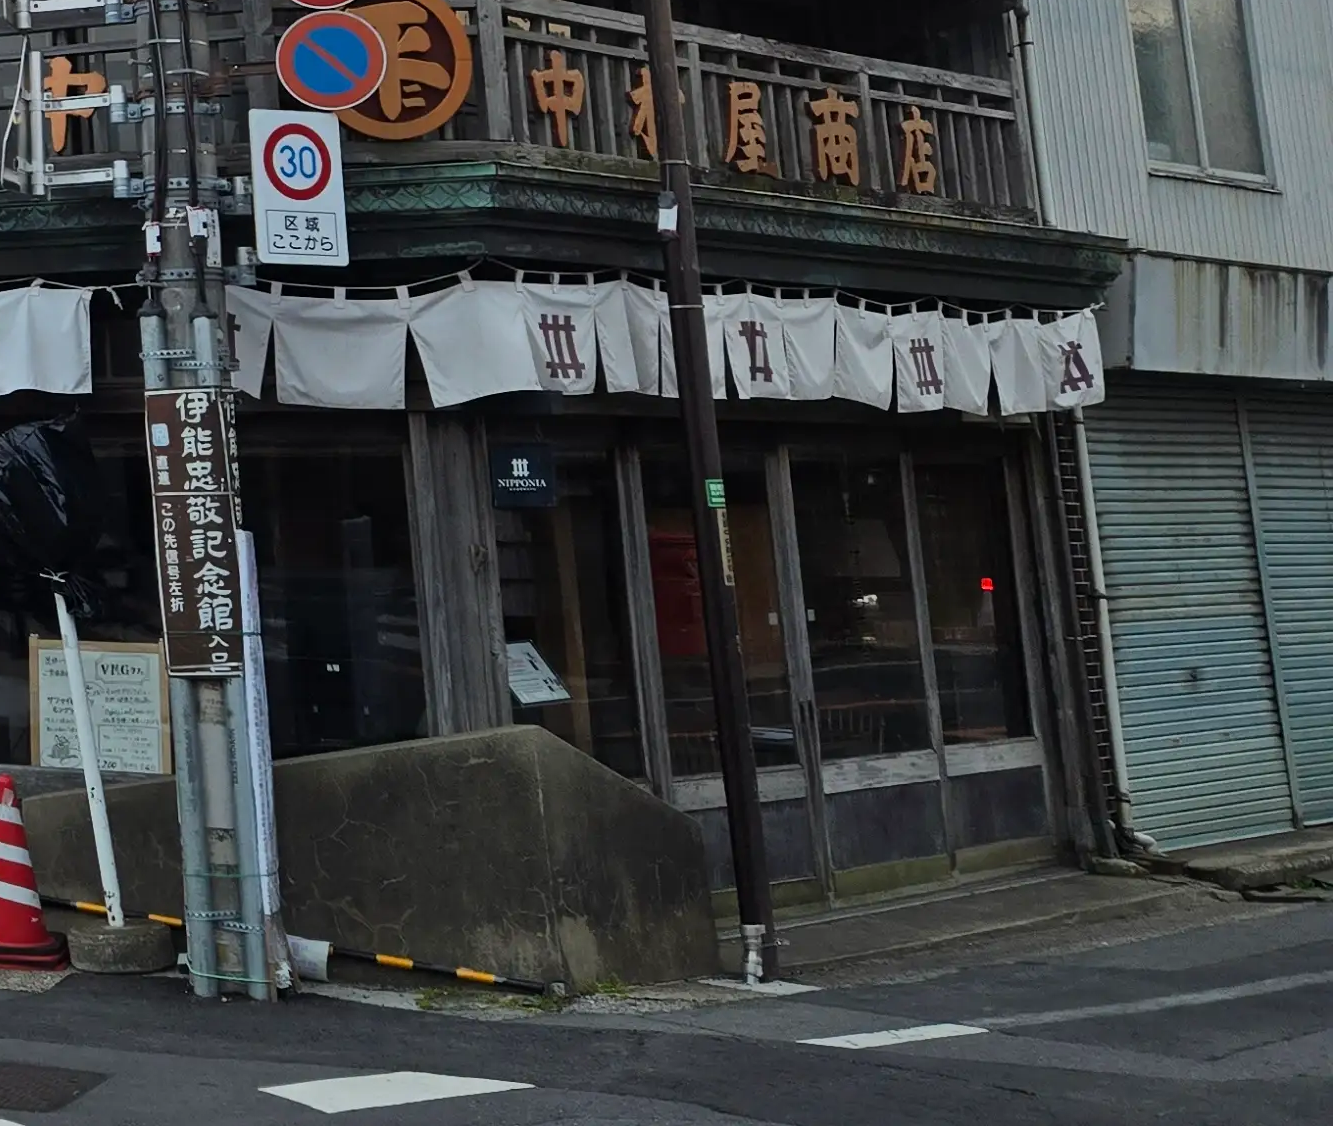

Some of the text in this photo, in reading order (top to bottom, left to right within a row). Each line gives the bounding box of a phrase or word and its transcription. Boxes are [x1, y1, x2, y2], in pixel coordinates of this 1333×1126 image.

[279, 145, 317, 179] 30
[284, 215, 320, 232] 区域
[272, 234, 334, 251] ここから
[497, 478, 547, 487] NIPPONIA
[161, 502, 184, 613] この先信号左折
